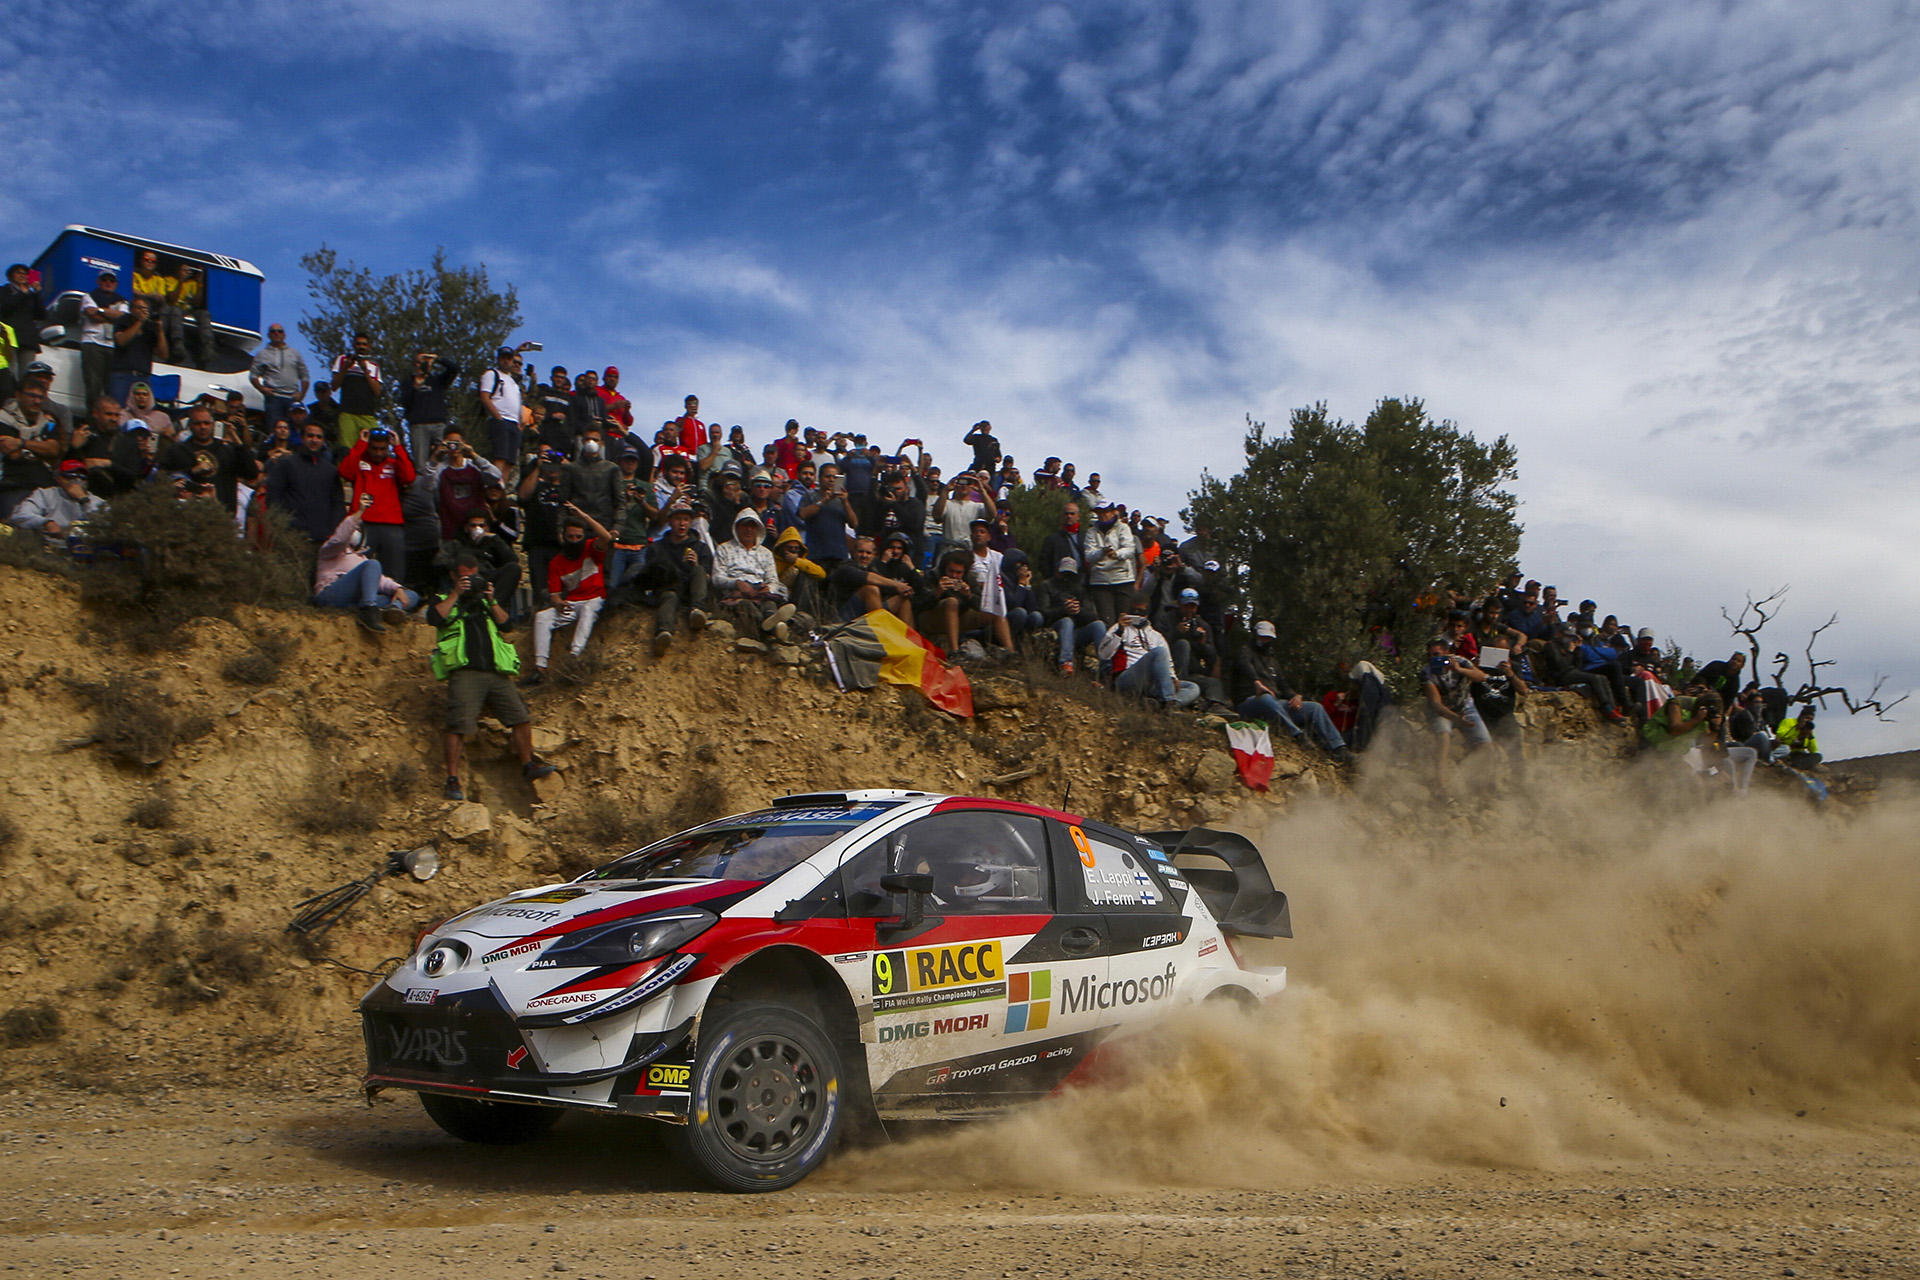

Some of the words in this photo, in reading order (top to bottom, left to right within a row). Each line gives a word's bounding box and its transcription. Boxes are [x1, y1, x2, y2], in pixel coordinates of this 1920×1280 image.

[1069, 825, 1096, 868] 9
[1086, 869, 1100, 883] E.
[1101, 869, 1133, 887] Lappi
[1092, 891, 1103, 905] J.
[1105, 891, 1135, 905] Ferm
[481, 951, 509, 965] DMG
[510, 941, 542, 957] MORI
[531, 959, 558, 968] PIAA
[916, 944, 995, 986] RACC
[875, 953, 893, 994] 9
[526, 993, 597, 1009] KONECRANES
[576, 960, 689, 1020] Panasonic
[884, 999, 896, 1007] FIA
[897, 996, 915, 1005] World
[916, 994, 932, 1004] Rally
[933, 990, 977, 1003] Championship
[1060, 961, 1176, 1015] Microsoft
[879, 1021, 930, 1043] DMG
[933, 1014, 990, 1035] MORI
[649, 1068, 690, 1084] OMP
[951, 1064, 996, 1080] TOYOTA
[1039, 1047, 1074, 1060] Racing
